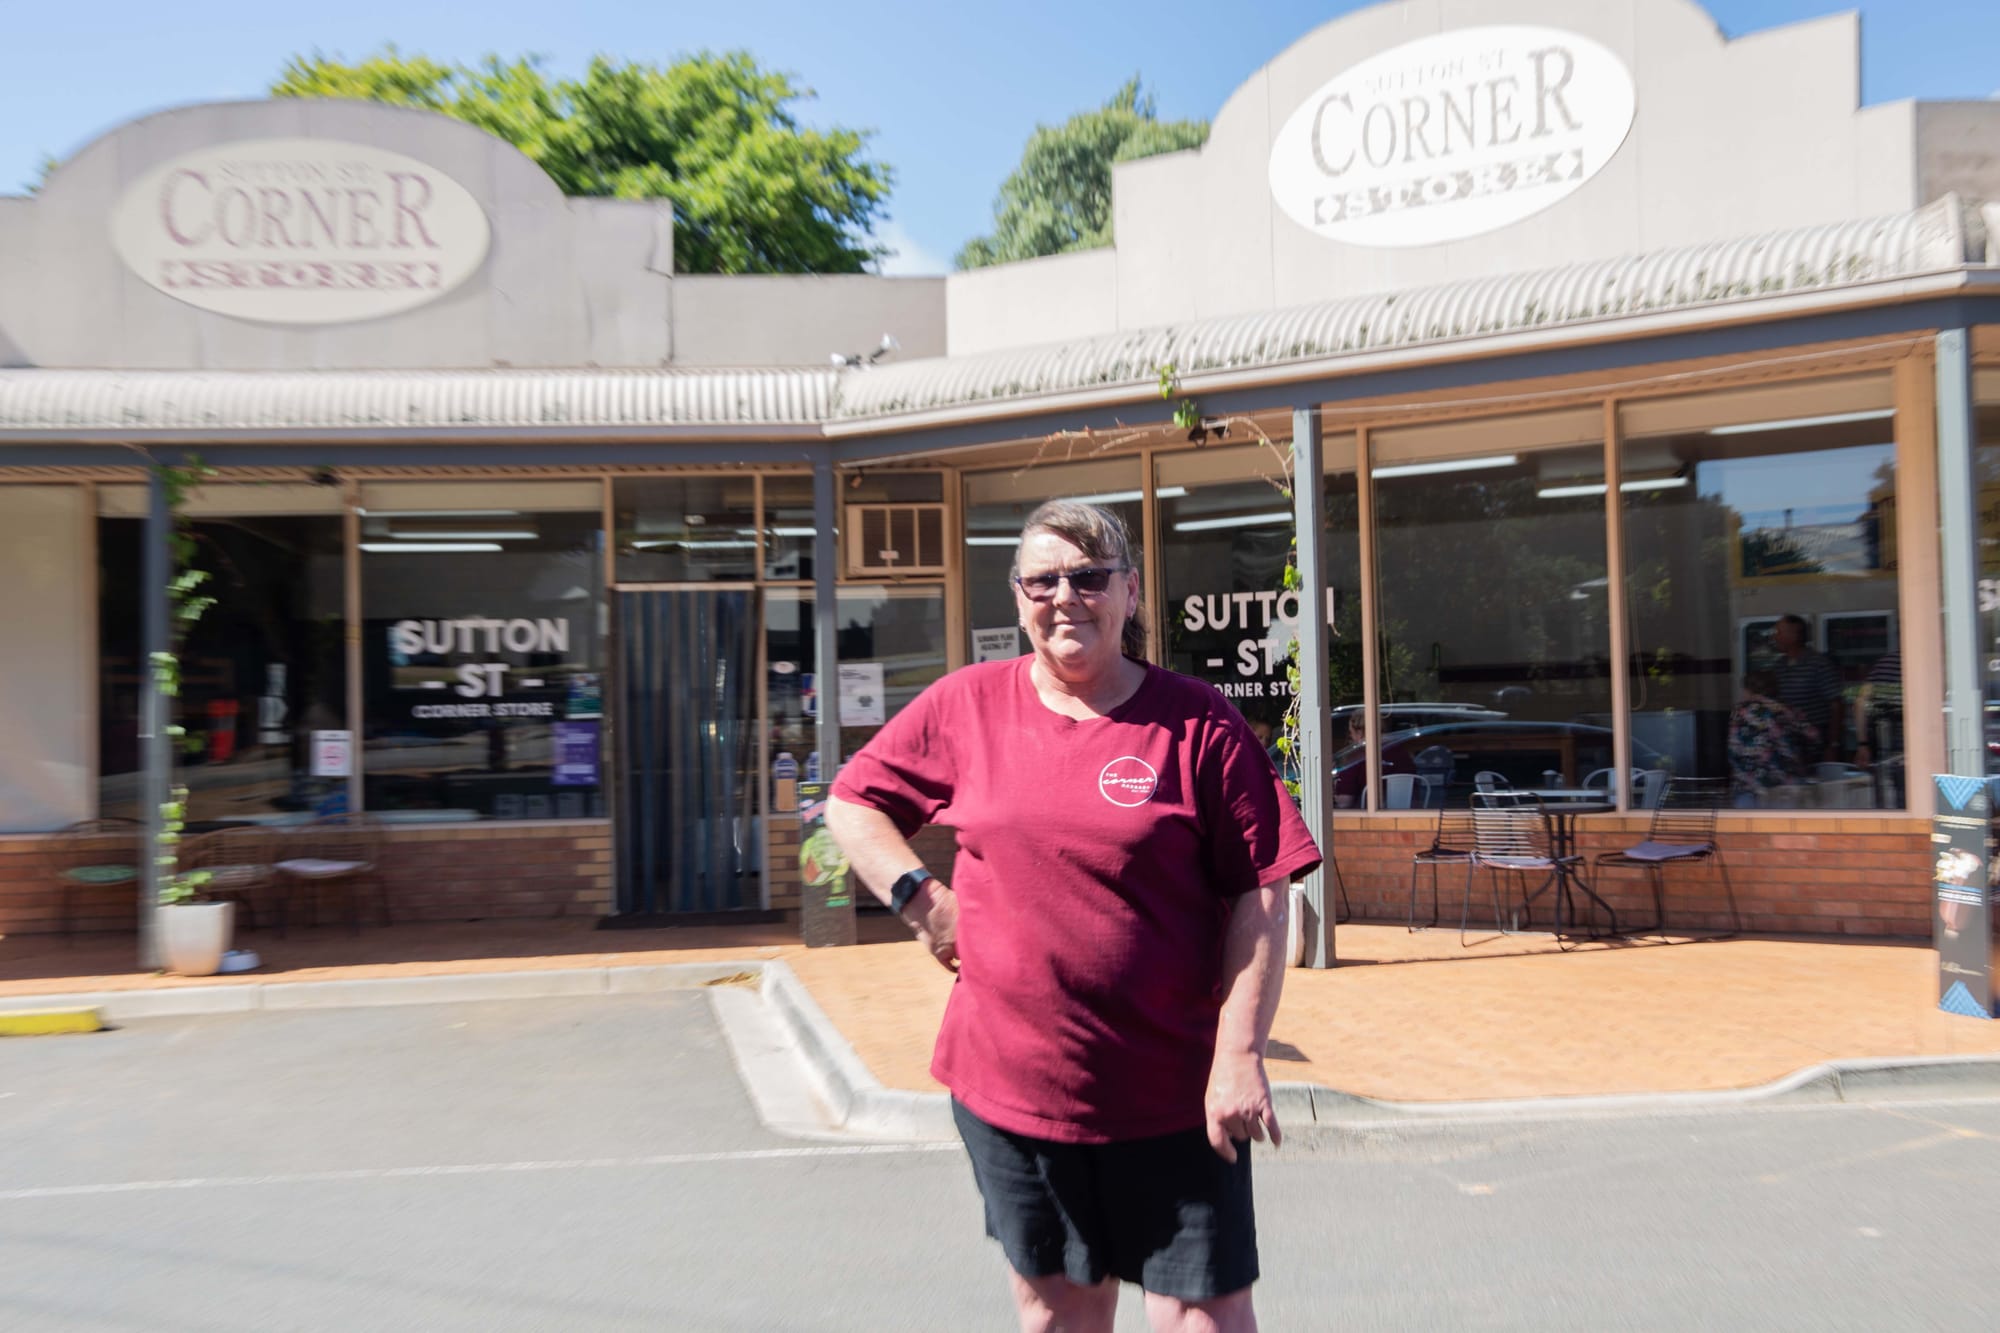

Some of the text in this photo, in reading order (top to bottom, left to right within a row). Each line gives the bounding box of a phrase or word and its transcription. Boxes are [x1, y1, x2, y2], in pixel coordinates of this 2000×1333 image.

[1311, 46, 1584, 178] CORNER
[159, 169, 442, 249] CORNER
[1184, 586, 1335, 631] SUTTO
[396, 617, 569, 654] SUTTON
[1237, 639, 1279, 676] ST
[456, 663, 510, 697] ST
[411, 702, 553, 718] CORNER STORE
